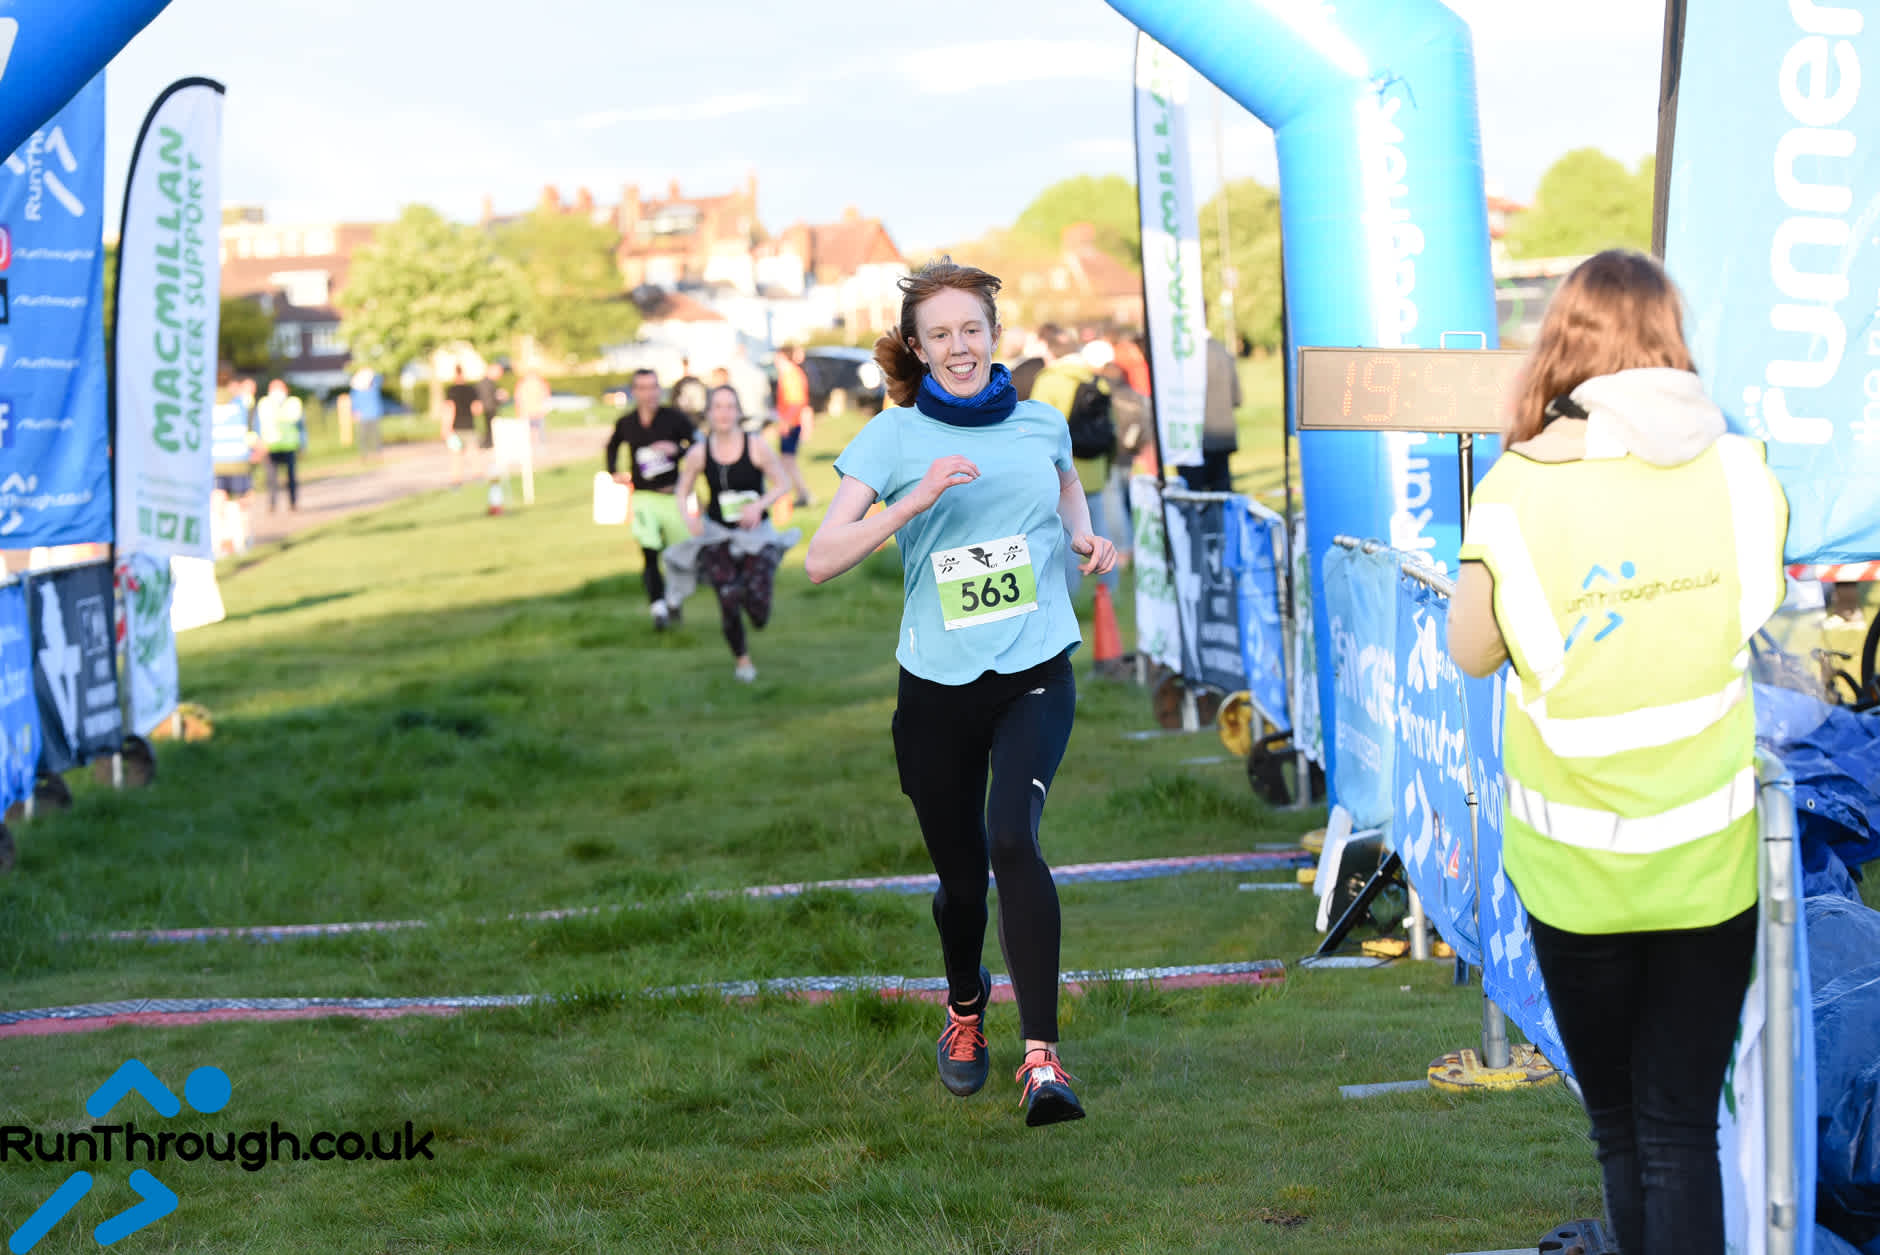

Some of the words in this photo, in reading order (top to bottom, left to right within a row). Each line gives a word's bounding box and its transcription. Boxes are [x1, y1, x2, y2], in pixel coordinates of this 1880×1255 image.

[152, 126, 184, 453] MACMILLAN
[183, 152, 205, 306] SUPPORT
[184, 318, 205, 452] CANCER
[961, 572, 1020, 612] 563
